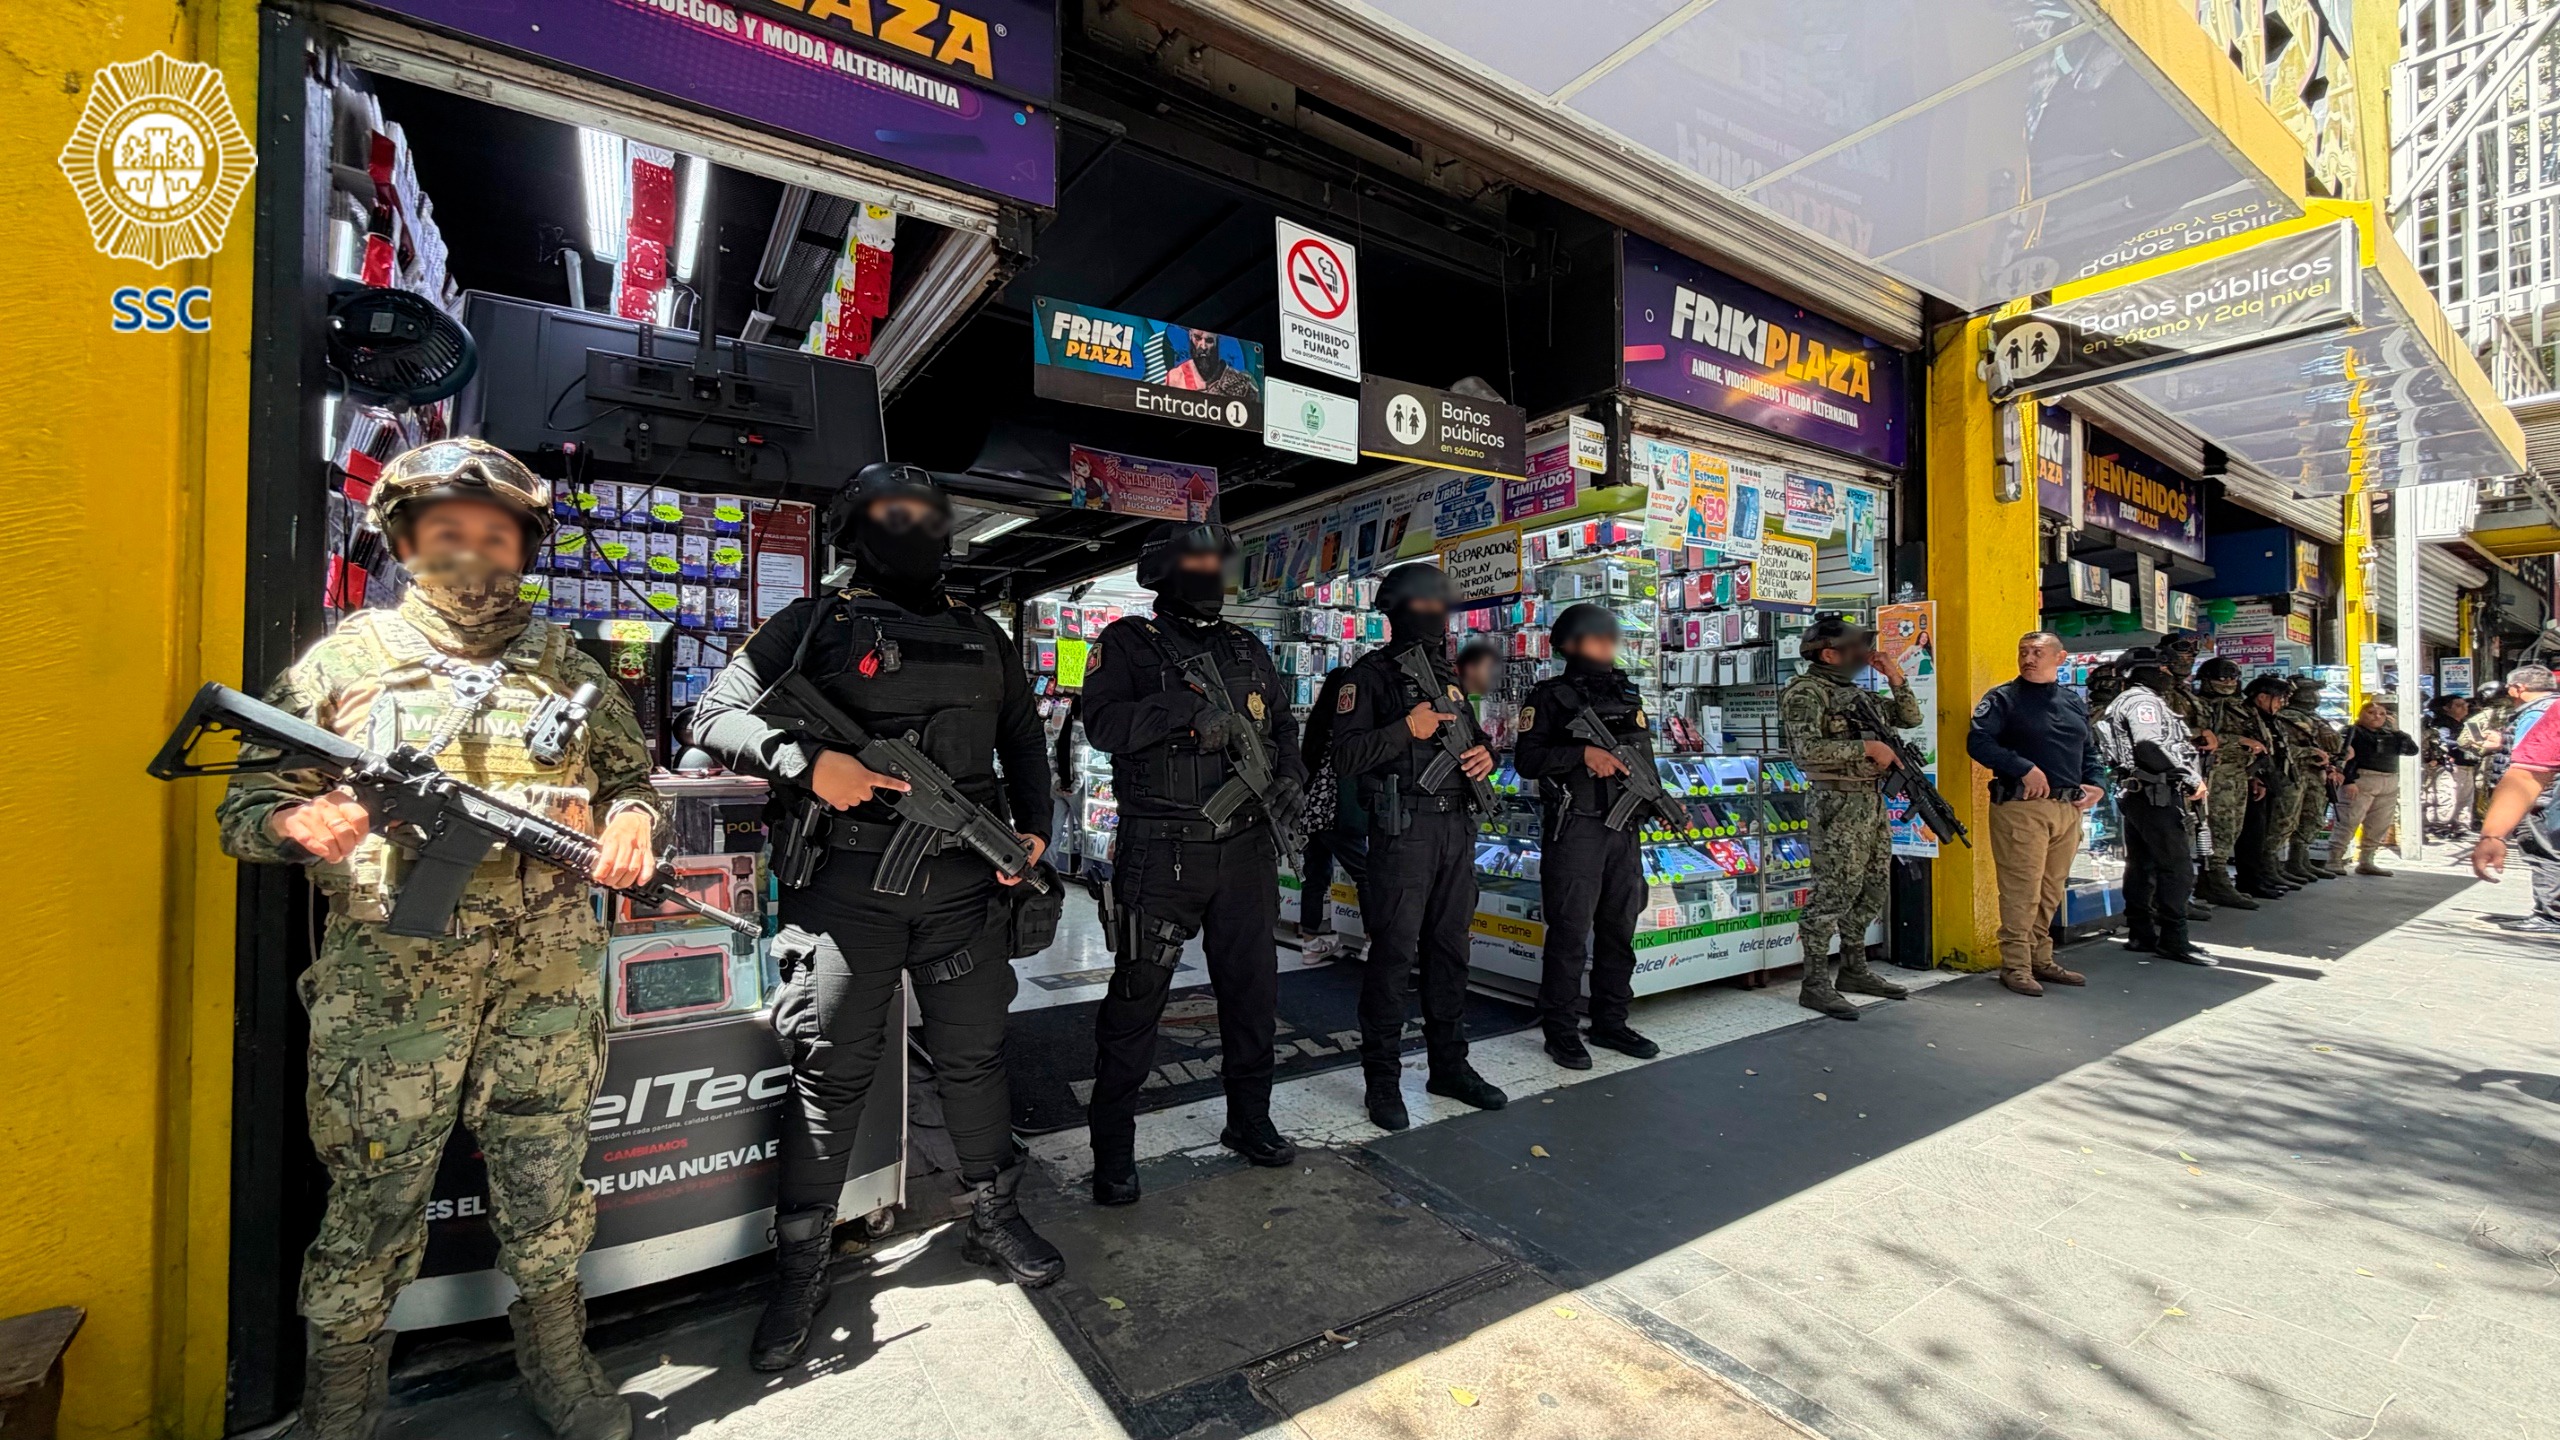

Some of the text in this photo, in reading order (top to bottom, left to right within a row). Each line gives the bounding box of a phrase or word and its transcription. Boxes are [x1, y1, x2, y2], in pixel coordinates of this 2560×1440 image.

[743, 17, 759, 39] Y
[762, 22, 828, 65] MODA
[832, 49, 961, 109] ALTERNATIVA
[2080, 256, 2332, 337] Baños públicos
[2082, 278, 2331, 355] en sótano y 2do nivel
[1051, 311, 1134, 351] FRIKI
[1291, 323, 1350, 350] PROHIBIDO
[1066, 340, 1133, 368] PLAZA
[1303, 339, 1339, 359] FUMAR
[1135, 387, 1241, 424] Entrada 1
[1725, 368, 1780, 403] VIDEOJUEGOS
[1788, 391, 1811, 412] MODA
[1812, 398, 1859, 429] ALTERNATIVA
[1441, 401, 1491, 427] Baños
[1441, 424, 1505, 448] públicos
[2039, 424, 2065, 465] IKI
[1440, 444, 1485, 459] en sótano
[1578, 441, 1598, 456] Local
[1694, 470, 1724, 484] Estrena
[1731, 465, 1761, 478] SAMSUNG
[2039, 458, 2063, 486] AZA
[1436, 483, 1462, 501] LIBRE
[1506, 471, 1573, 500] ILIMITADOS
[1763, 486, 1785, 501] elce
[2083, 450, 2187, 523] BIENVENIDOS
[1119, 492, 1154, 503] SEGUNDO
[1156, 497, 1173, 505] PISO
[1353, 499, 1383, 513] SAMSUNG
[1514, 506, 1520, 517] 6
[2220, 646, 2272, 655] ILIMITADOS
[403, 714, 522, 737] MINA
[1498, 923, 1532, 938] realme
[1668, 926, 1704, 943] Infinix
[1716, 916, 1749, 933] Infinix
[1762, 912, 1791, 925] nfinix
[1739, 939, 1764, 954] telce
[1766, 933, 1795, 950] telcel
[1635, 956, 1667, 974] elcel
[588, 1065, 793, 1131] elTec
[590, 1132, 620, 1142] recisión
[621, 1130, 632, 1138] en
[632, 1126, 651, 1136] cada
[684, 1115, 709, 1127] calidad
[710, 1113, 724, 1123] que
[724, 1110, 732, 1118] se
[733, 1105, 755, 1116] instala
[756, 1103, 768, 1112] con
[603, 1137, 688, 1162] CAMBIAMOS
[584, 1175, 615, 1197] DE
[618, 1164, 676, 1191] UNA
[679, 1144, 764, 1180] NUEVA
[765, 1138, 780, 1160] E
[457, 1195, 487, 1217] EL
